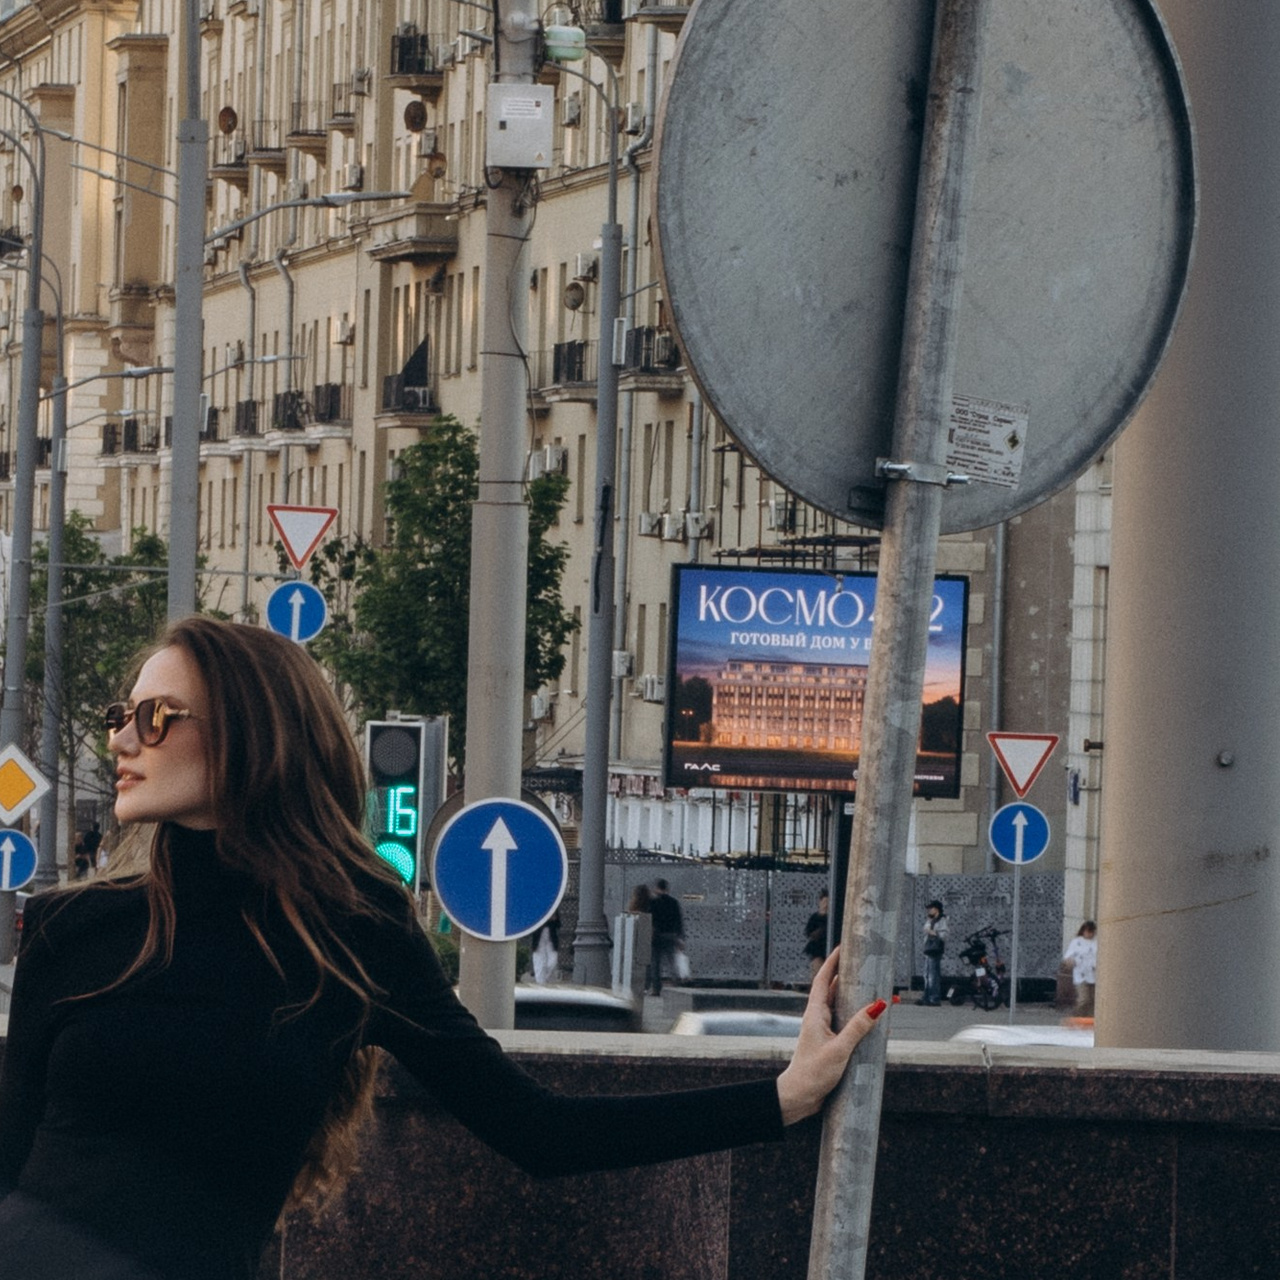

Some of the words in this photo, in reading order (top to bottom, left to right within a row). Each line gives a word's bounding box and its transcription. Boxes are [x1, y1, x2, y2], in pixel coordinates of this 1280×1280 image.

[698, 585, 864, 628] КОСМО
[730, 631, 806, 648] ГОТОВЫЙ
[810, 635, 846, 650] ДОМ
[850, 637, 864, 650] У
